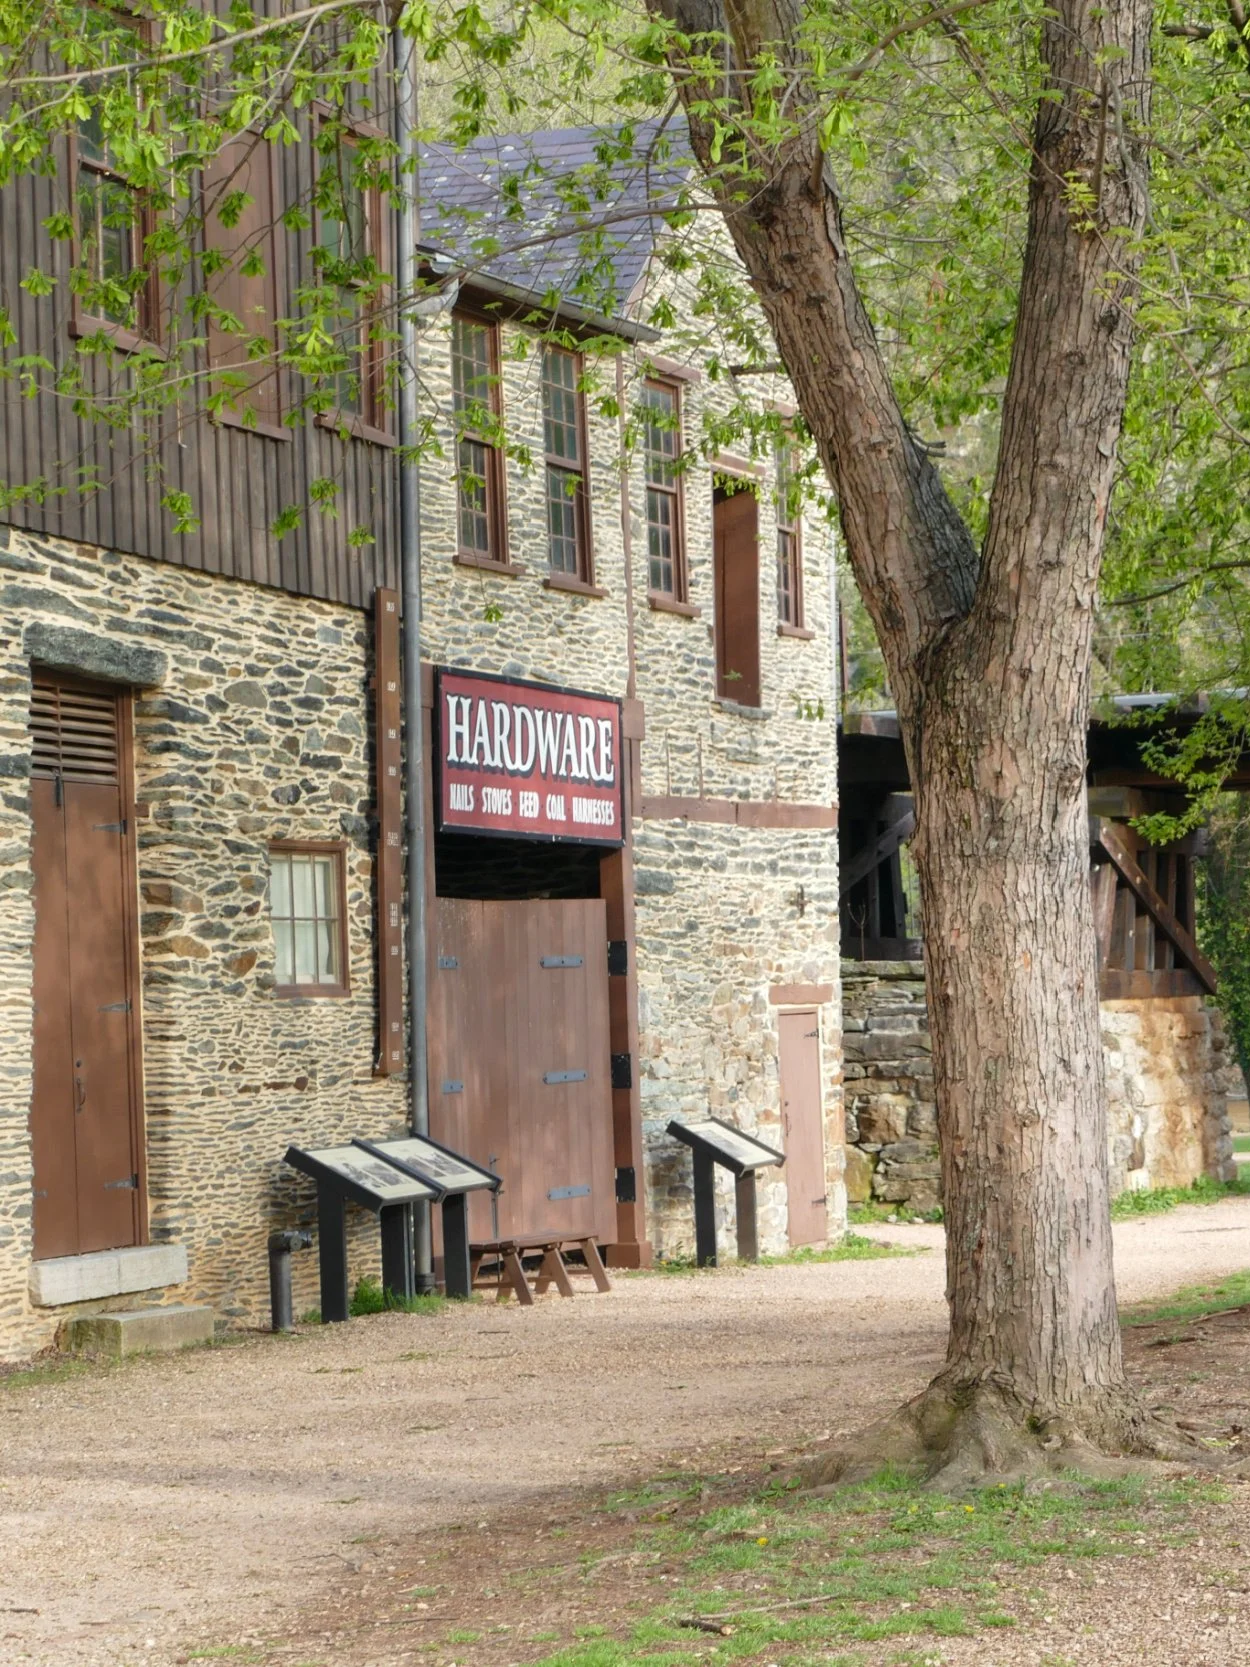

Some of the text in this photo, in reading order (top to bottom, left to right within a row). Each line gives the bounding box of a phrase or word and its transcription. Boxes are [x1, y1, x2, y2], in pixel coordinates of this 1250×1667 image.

[446, 694, 615, 783] HARDWARE
[449, 783, 615, 826] NAILS STOVES FEED COAL HARNESSES
